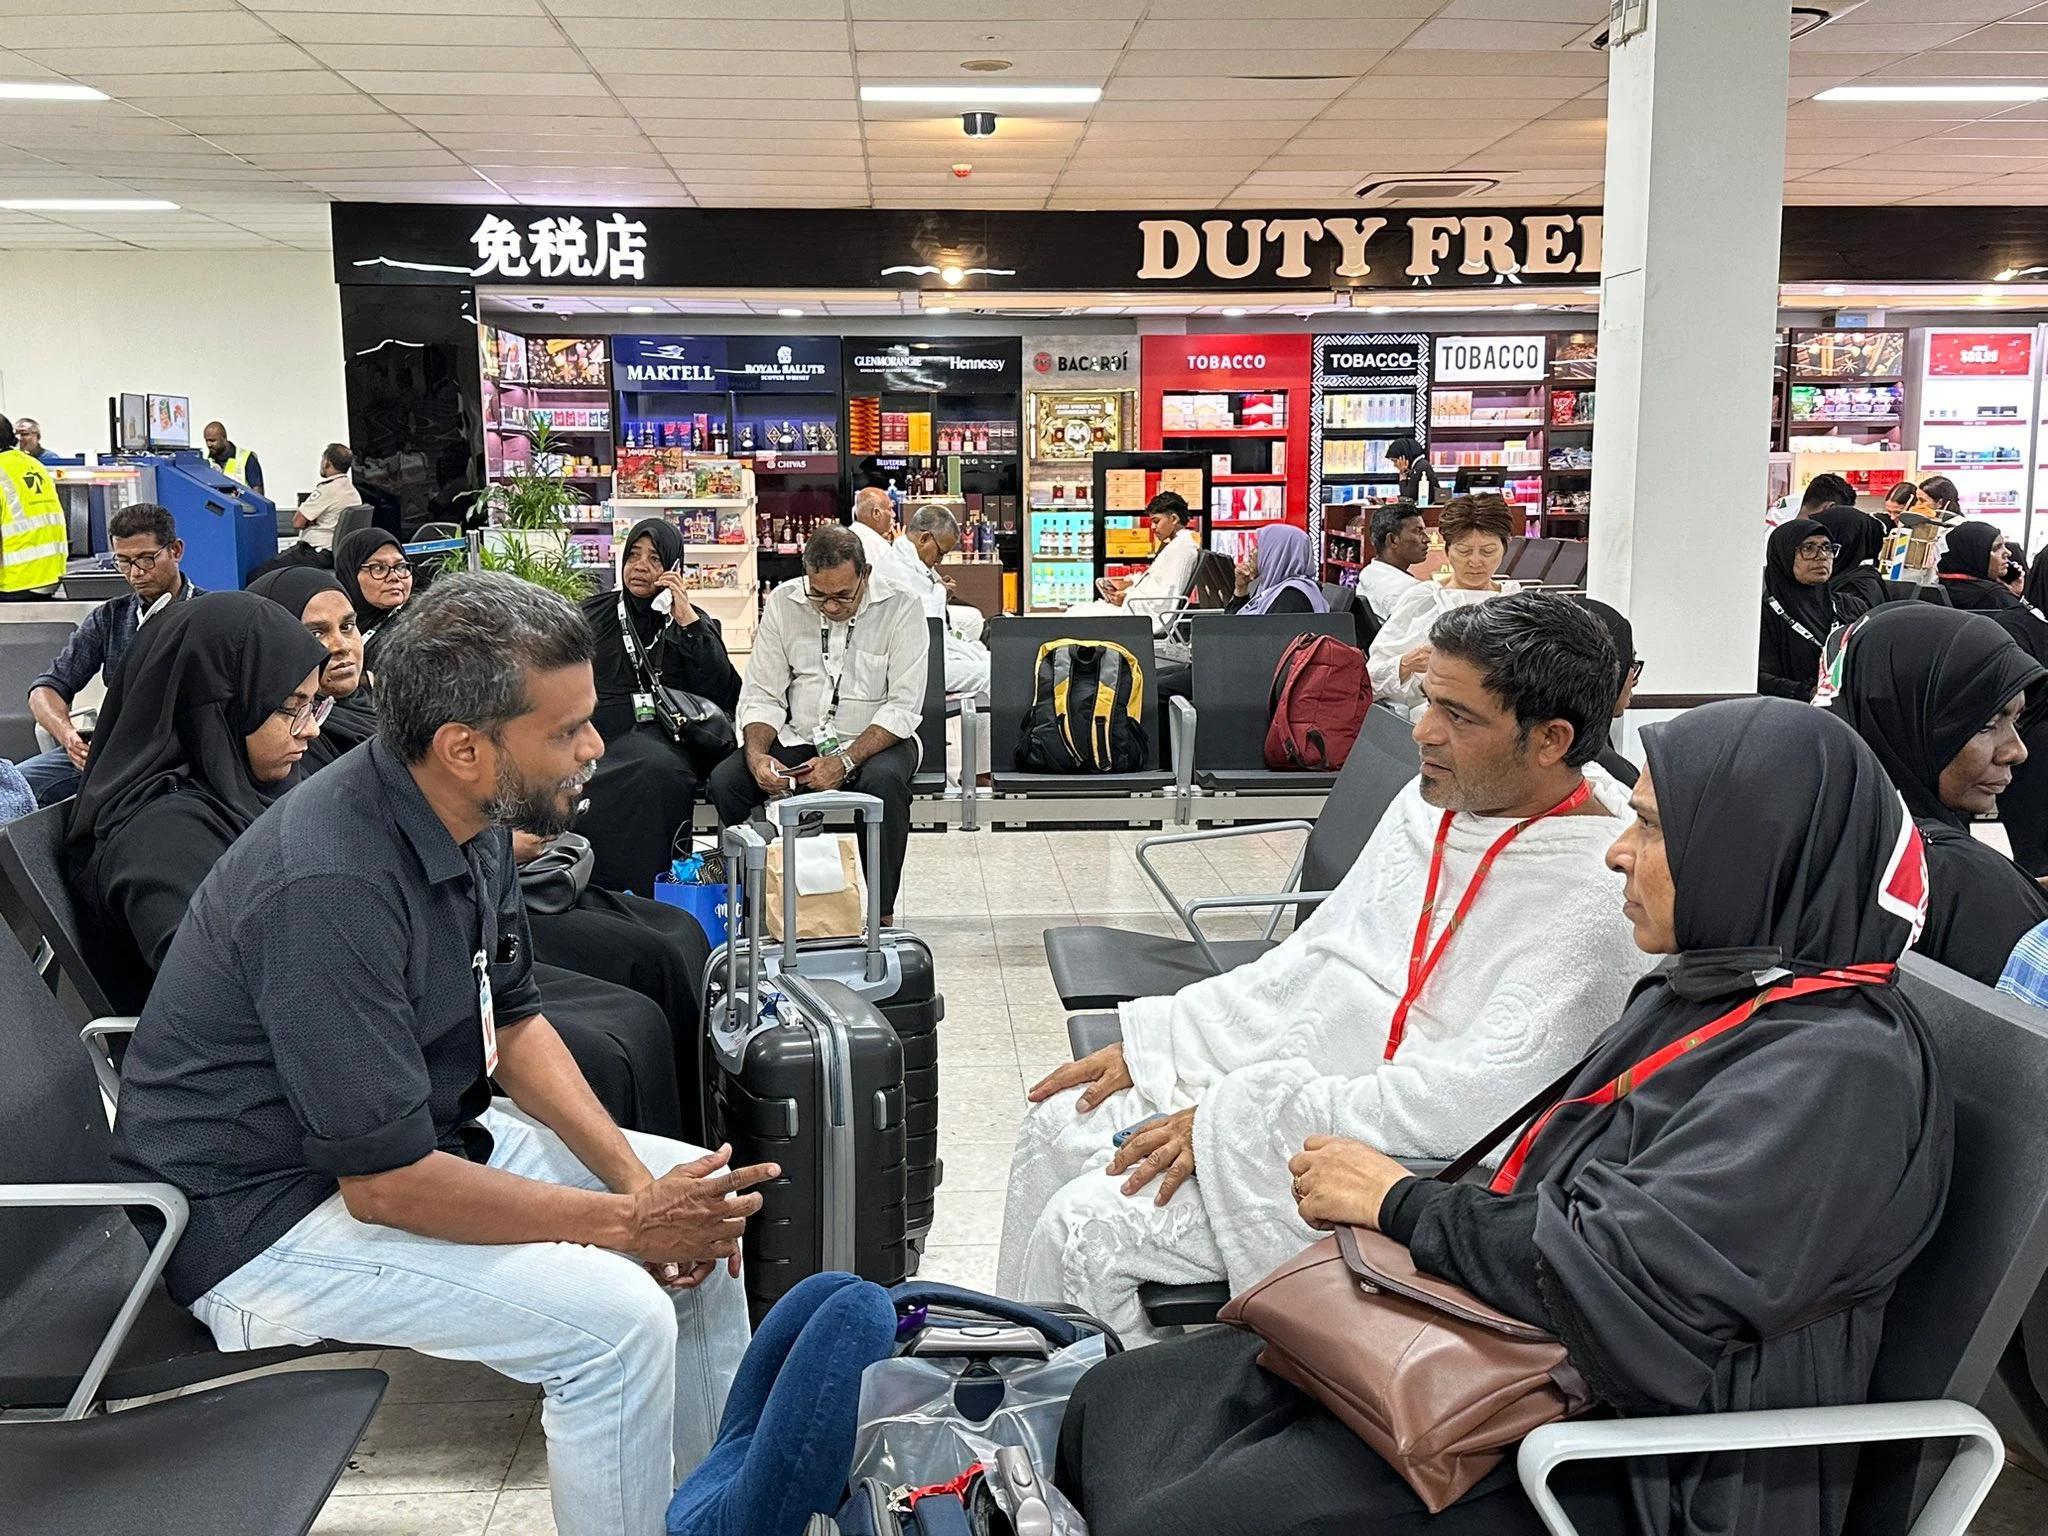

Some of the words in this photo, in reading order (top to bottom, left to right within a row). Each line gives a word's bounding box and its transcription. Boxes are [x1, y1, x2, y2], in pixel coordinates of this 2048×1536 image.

[470, 213, 648, 281] 免税店
[1137, 218, 1387, 280] DUTY
[950, 356, 1006, 372] Hennessy
[1187, 355, 1266, 369] TOBACCO
[1330, 353, 1412, 368] TOBACCO
[1442, 344, 1538, 370] TOBACCO
[627, 365, 715, 381] MARTELL
[745, 364, 781, 374] ROYAL
[782, 364, 825, 374] SALUTE
[777, 460, 807, 468] CHIVAS
